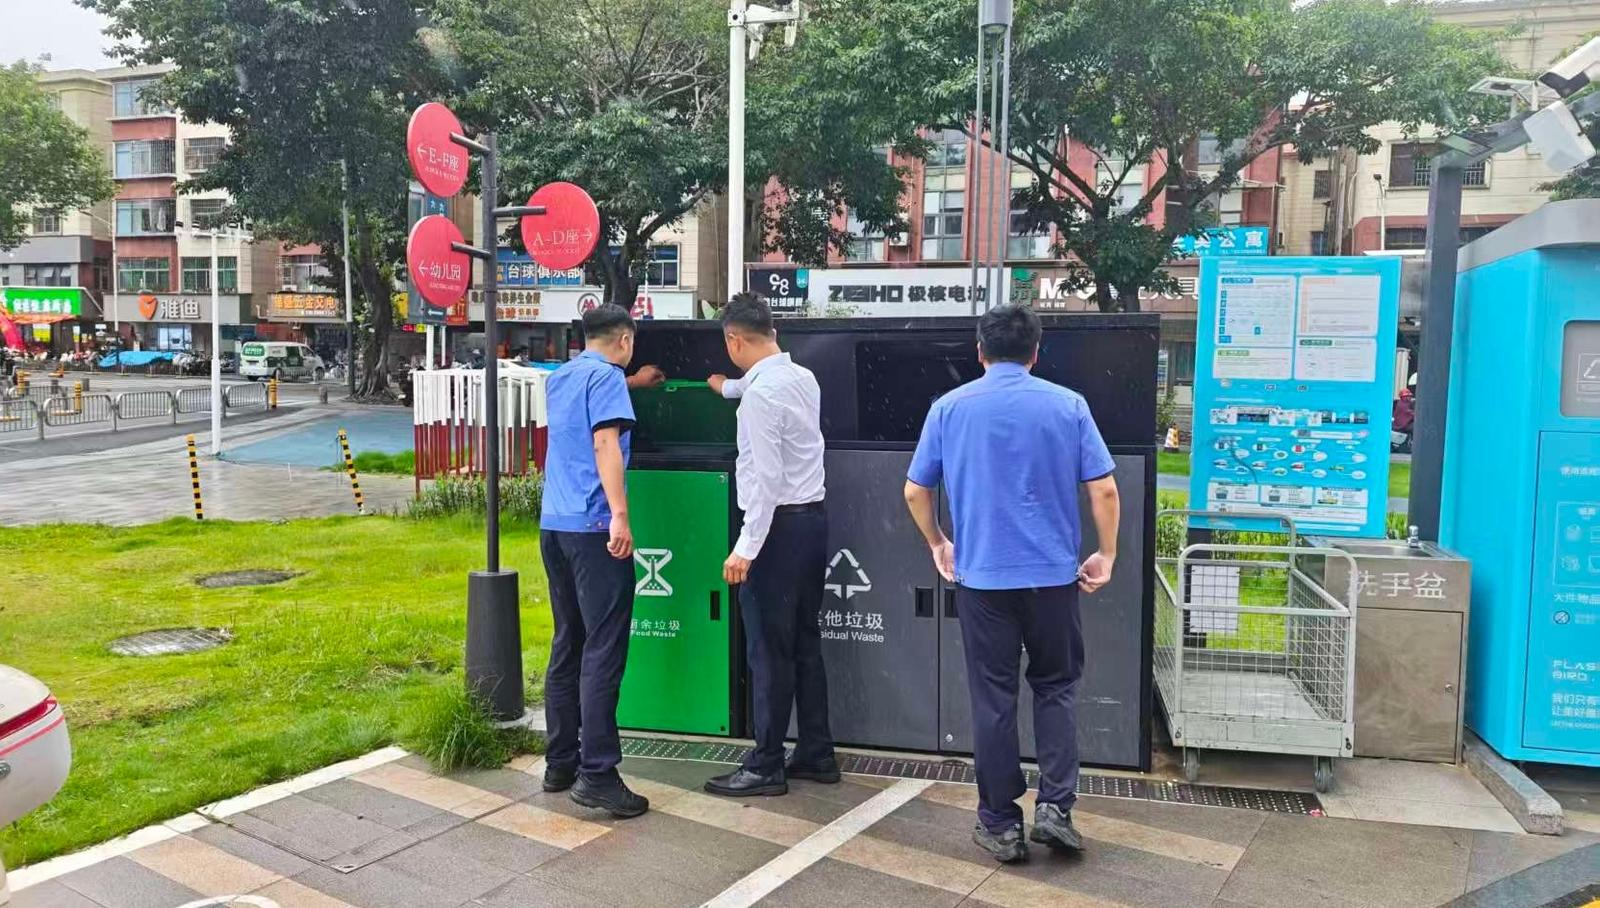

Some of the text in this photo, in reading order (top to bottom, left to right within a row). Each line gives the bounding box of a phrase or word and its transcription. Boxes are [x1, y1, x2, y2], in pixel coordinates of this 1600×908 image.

[429, 147, 460, 172] E-F座
[532, 228, 579, 246] A-D座
[430, 263, 461, 281] 幼儿园
[160, 299, 201, 320] 雅迪
[851, 631, 885, 643] Waste
